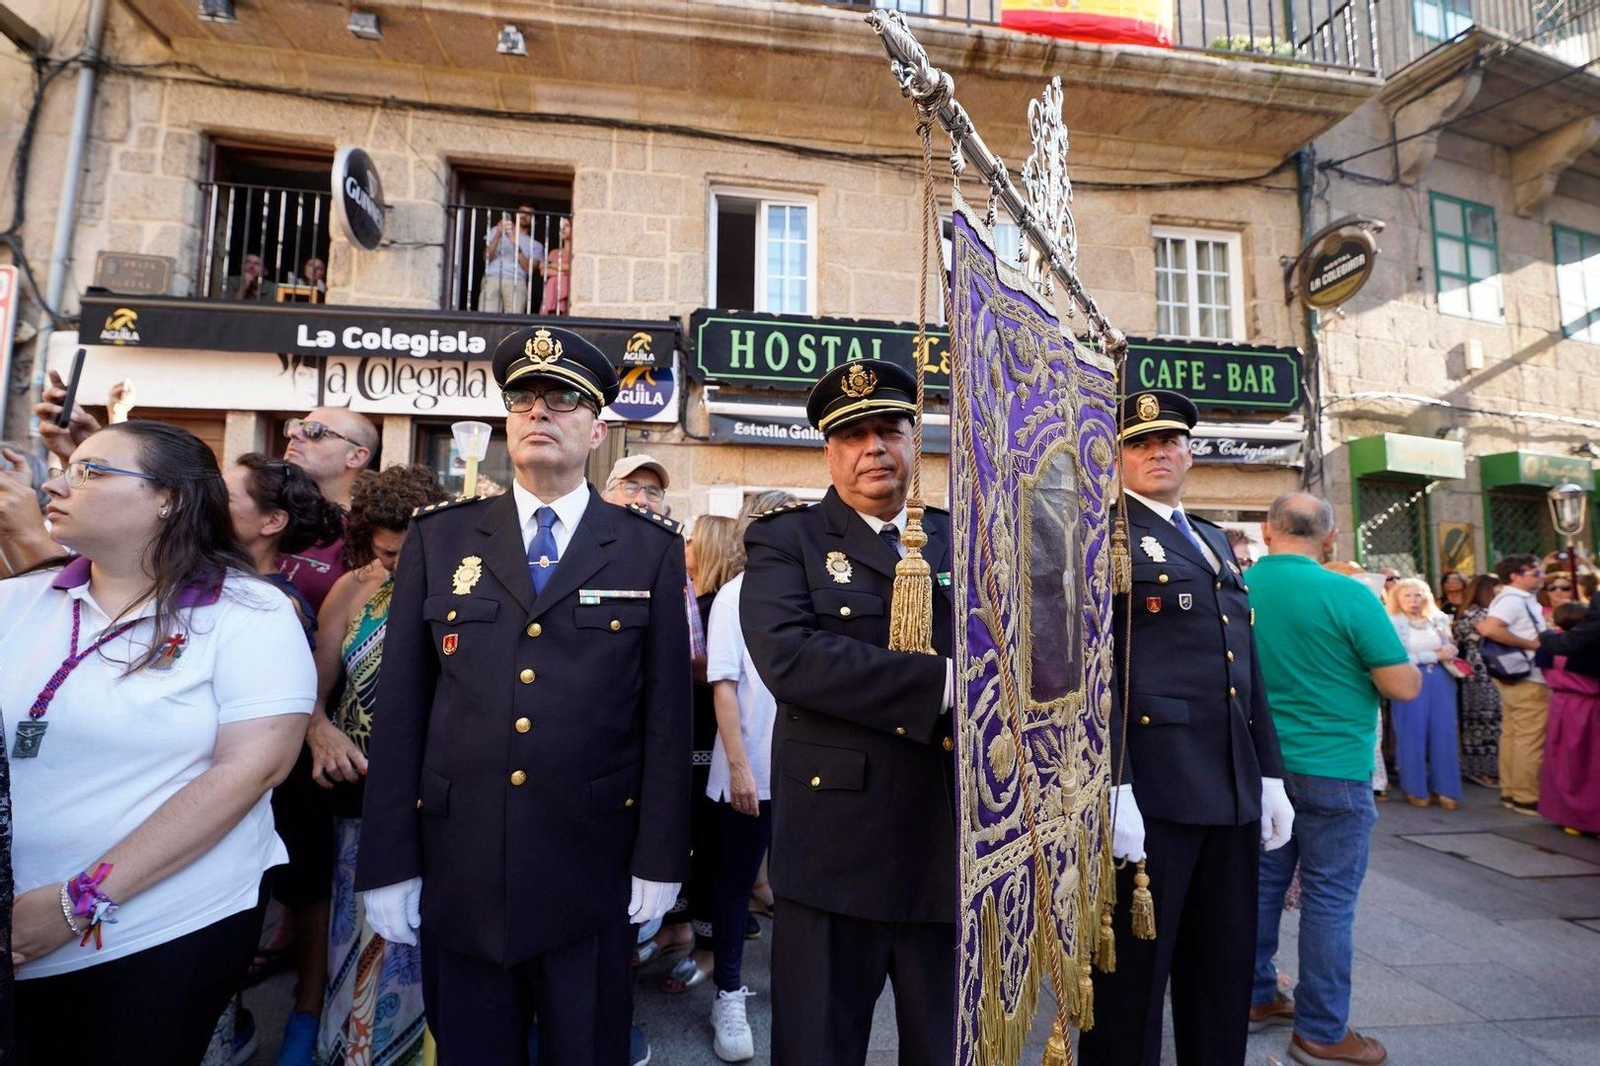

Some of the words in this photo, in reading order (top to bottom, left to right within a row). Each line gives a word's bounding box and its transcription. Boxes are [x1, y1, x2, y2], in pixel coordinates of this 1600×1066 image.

[297, 324, 336, 348] La
[342, 326, 487, 358] Colegiala
[1139, 357, 1206, 390] CAFE
[1227, 363, 1277, 394] BAR
[733, 421, 788, 438] Estrella
